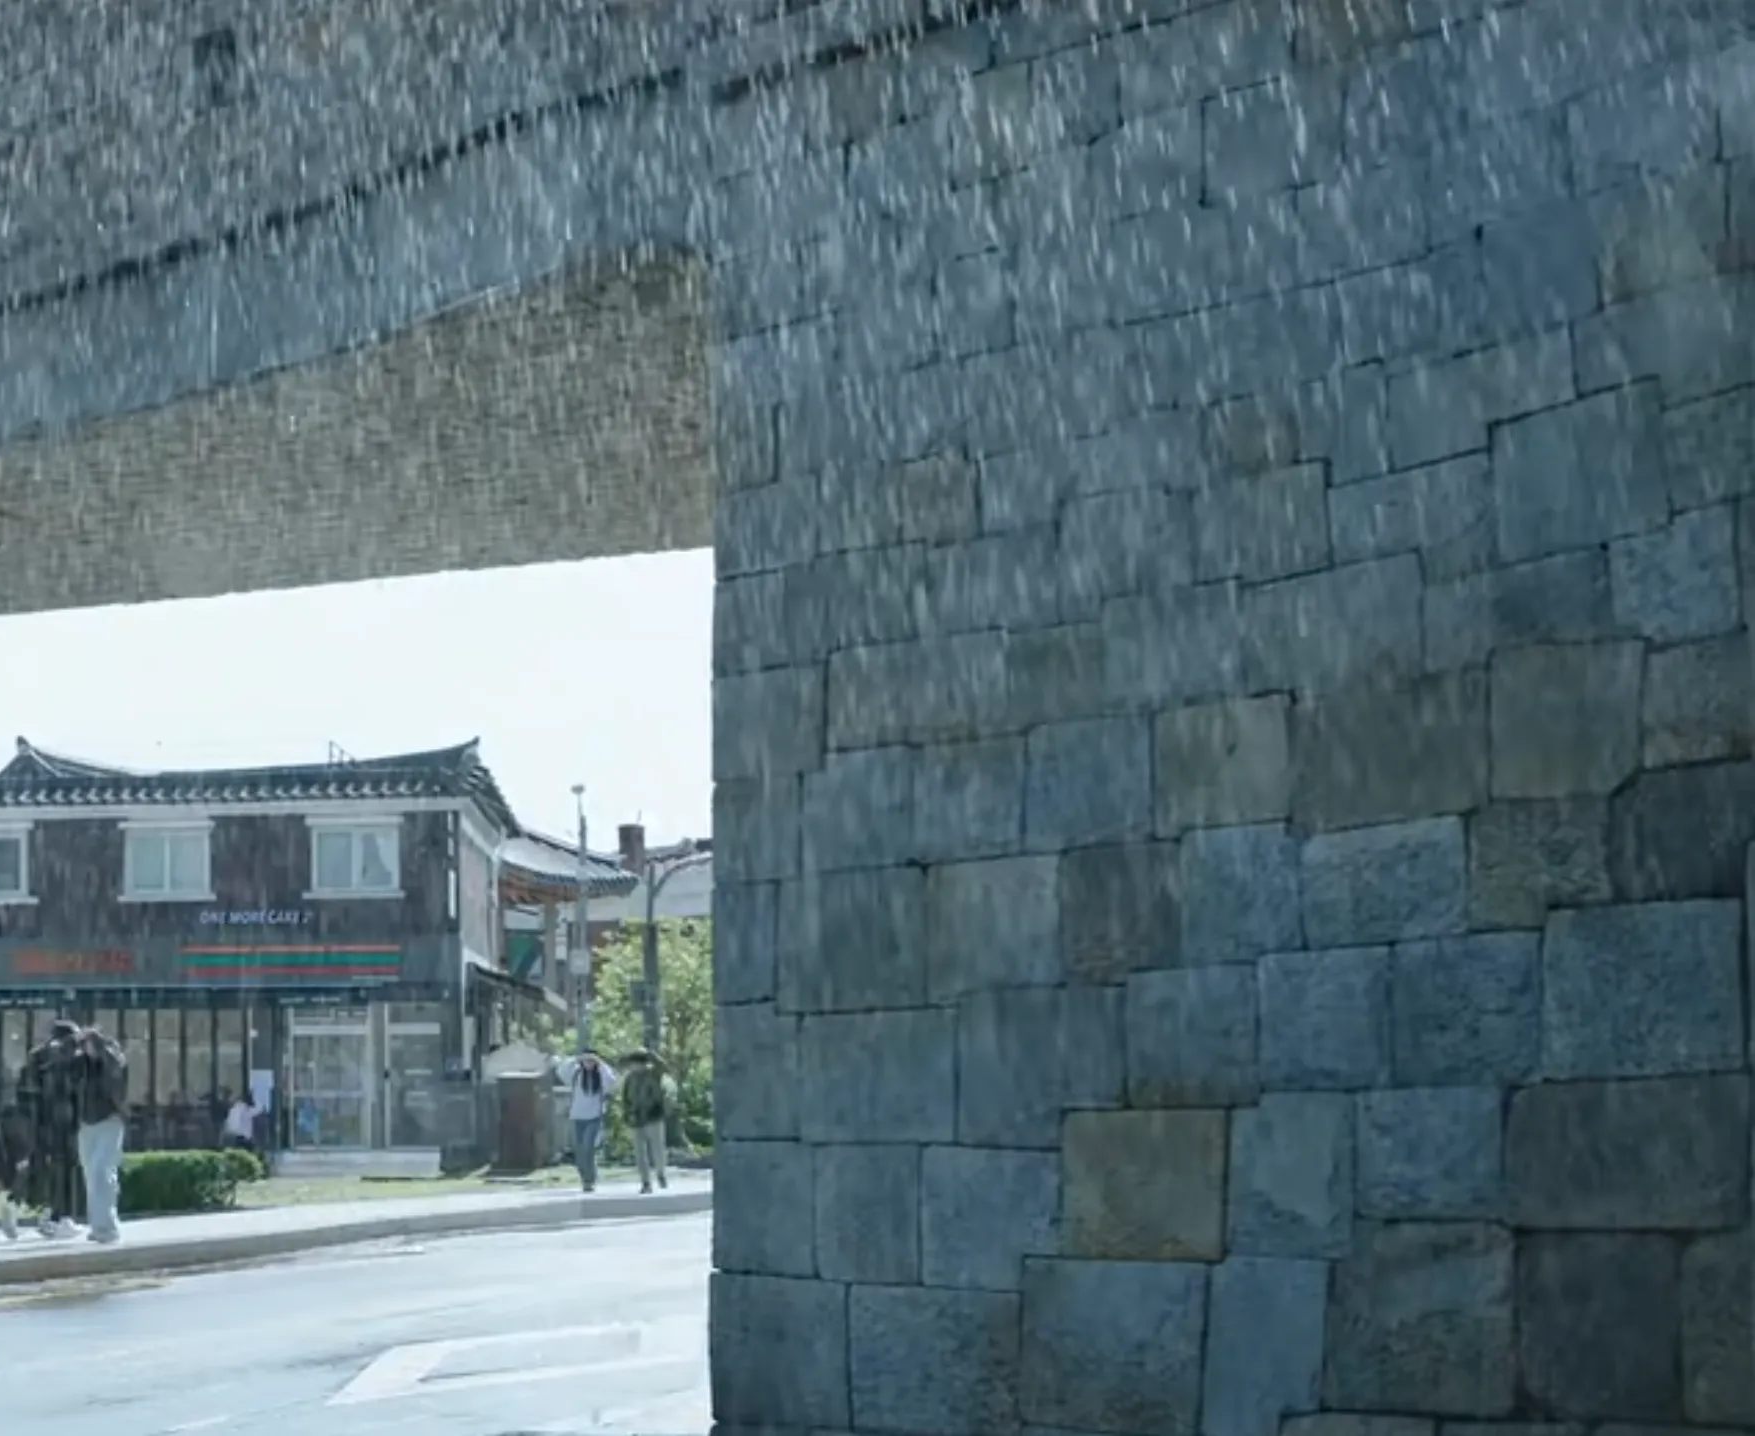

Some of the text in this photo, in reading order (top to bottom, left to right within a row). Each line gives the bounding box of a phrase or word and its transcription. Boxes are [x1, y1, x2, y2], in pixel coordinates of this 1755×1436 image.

[199, 910, 226, 925] ONE
[229, 909, 267, 925] MORE
[268, 909, 302, 925] CAKE
